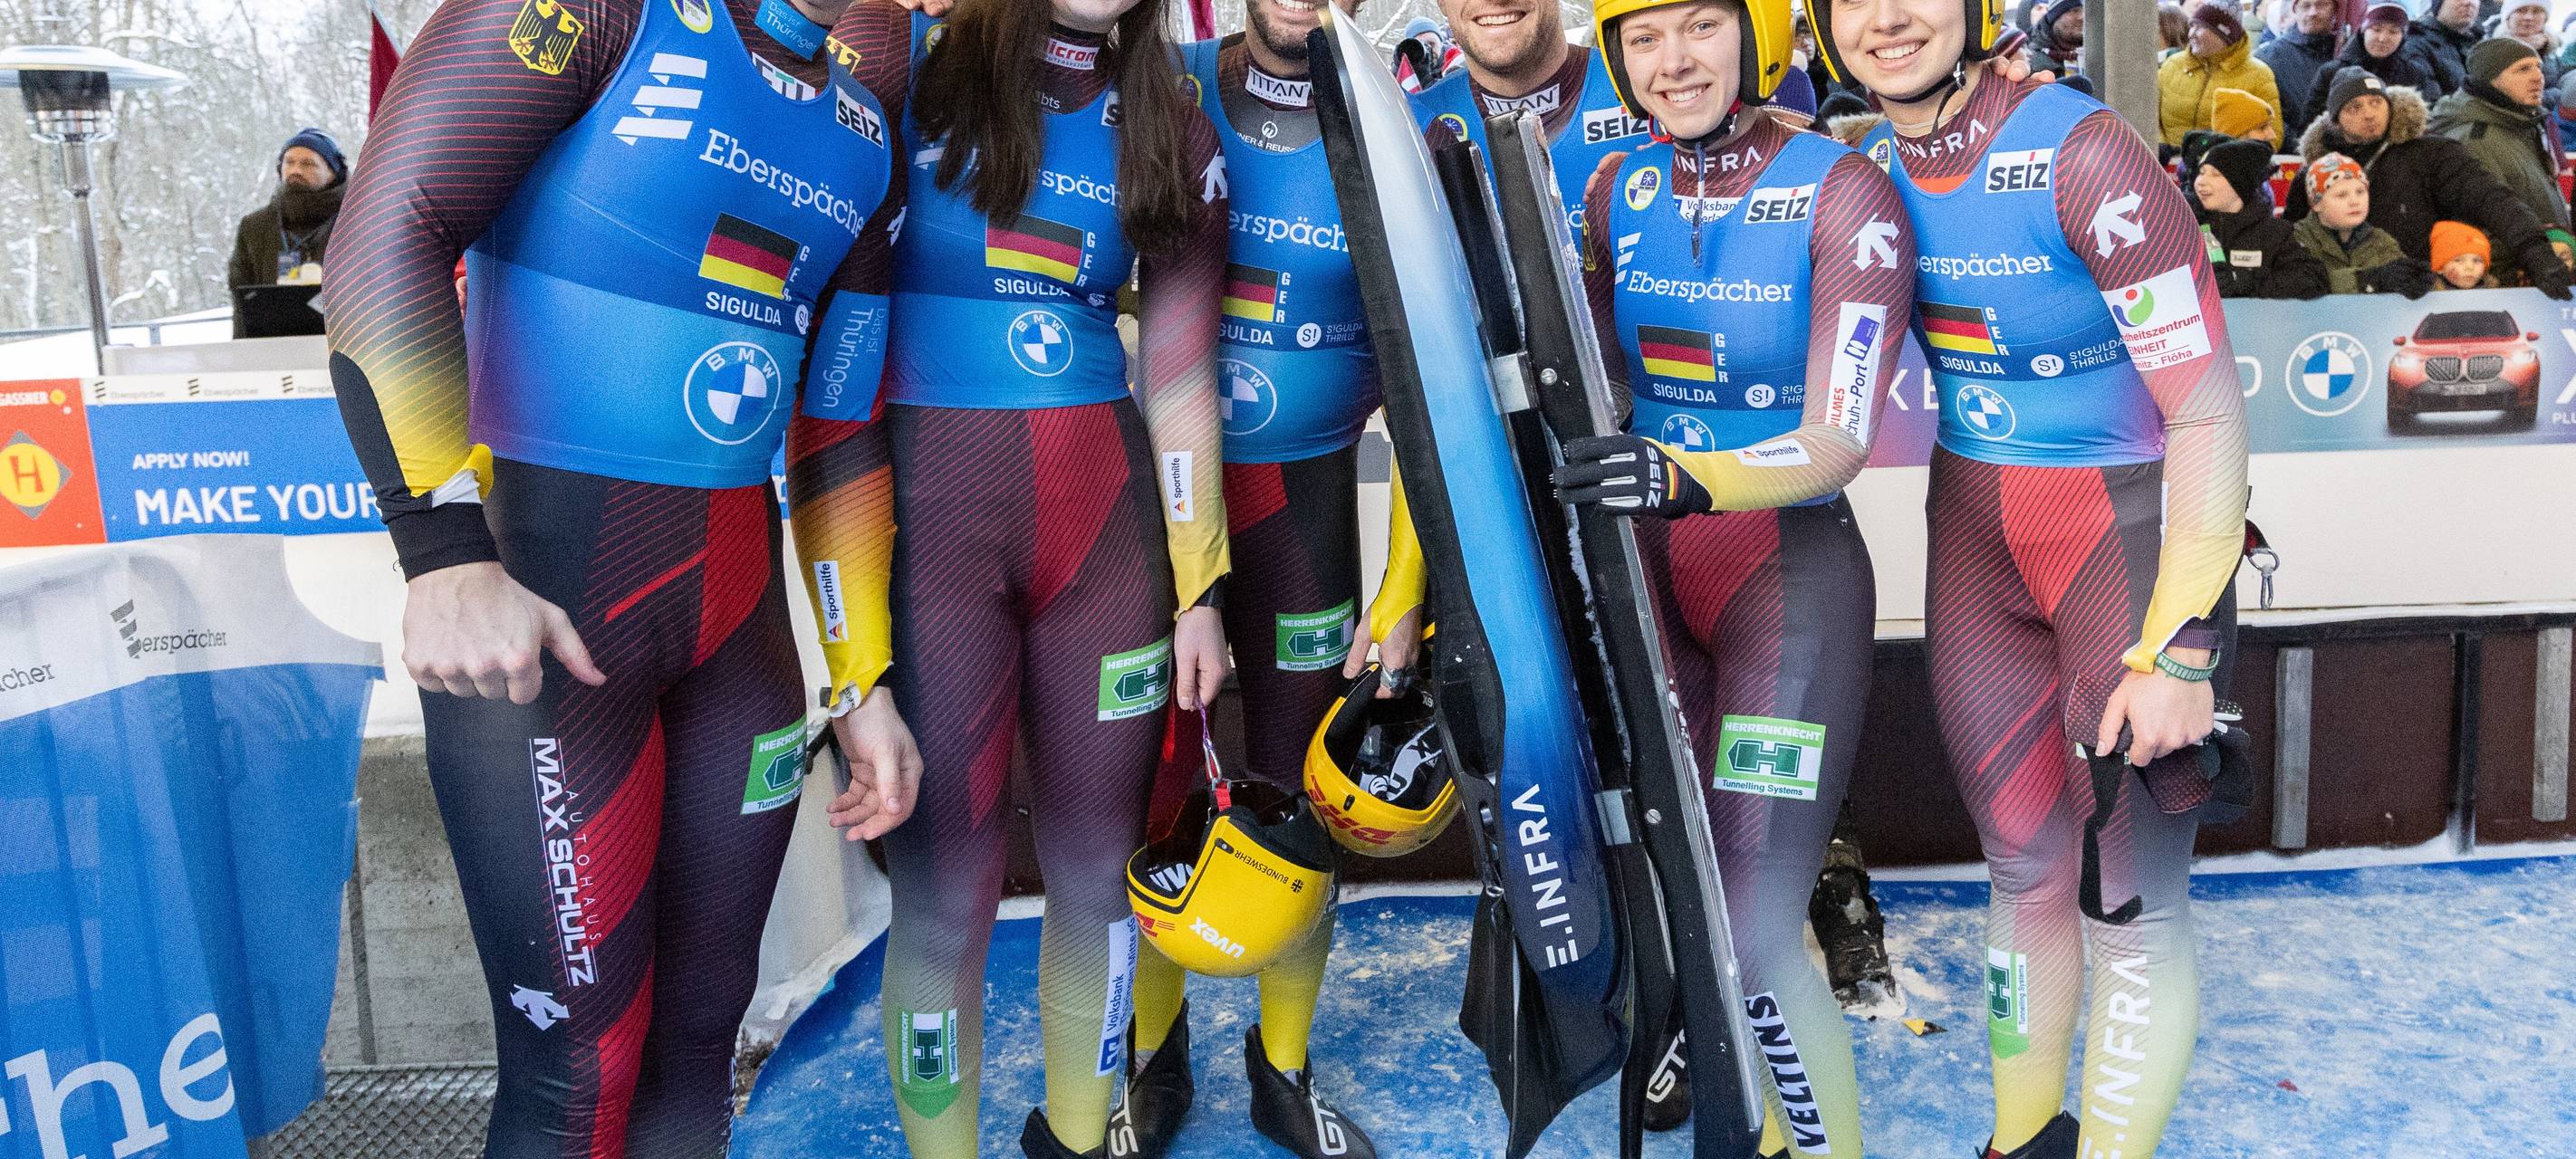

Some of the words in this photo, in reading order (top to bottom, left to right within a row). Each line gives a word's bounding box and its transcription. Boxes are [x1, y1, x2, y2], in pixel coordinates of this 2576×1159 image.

[1250, 69, 1304, 98] TITAN
[1484, 91, 1553, 111] TITAN
[837, 99, 882, 146] SEIZ
[699, 129, 864, 238] Eberspäche
[1988, 152, 2048, 191] SEIZ
[1748, 188, 1810, 222] SEIZ
[1628, 271, 1793, 302] Eberspächer
[706, 291, 782, 326] SIGULDA
[1015, 314, 1062, 332] BMW
[706, 348, 775, 378] BMW
[822, 308, 874, 407] Thüringen
[1940, 356, 2005, 375] SIGULDA
[2071, 350, 2117, 369] THRILLS
[2161, 350, 2193, 365] Flöha
[1653, 383, 1717, 403] SIGULDA
[1844, 363, 1868, 436] chuh-Port
[1961, 388, 2002, 405] BMW
[132, 452, 187, 470] APPLY
[193, 450, 250, 468] NOW!
[1755, 444, 1799, 458] Sporthilfe
[1171, 456, 1183, 499] Sporthilfe
[1646, 445, 1666, 508] SEIZ
[135, 485, 261, 526] MAKE
[822, 562, 838, 619] Sporthilfe
[1111, 703, 1151, 716] Tunnelling
[1725, 722, 1821, 741] HERRENKNECHT
[533, 738, 568, 831] MAX
[1722, 780, 1764, 792] Tunnelling
[1767, 785, 1803, 796] Systems
[565, 790, 601, 943] AUTOHAUS
[1235, 849, 1289, 884] BUNDESWEHR
[1511, 784, 1578, 968] E.INFRA
[548, 838, 595, 987] SCHULTZ
[1188, 916, 1245, 958] uvex
[1107, 974, 1124, 1031] Volksbank
[1747, 997, 1826, 1148] VELTINS
